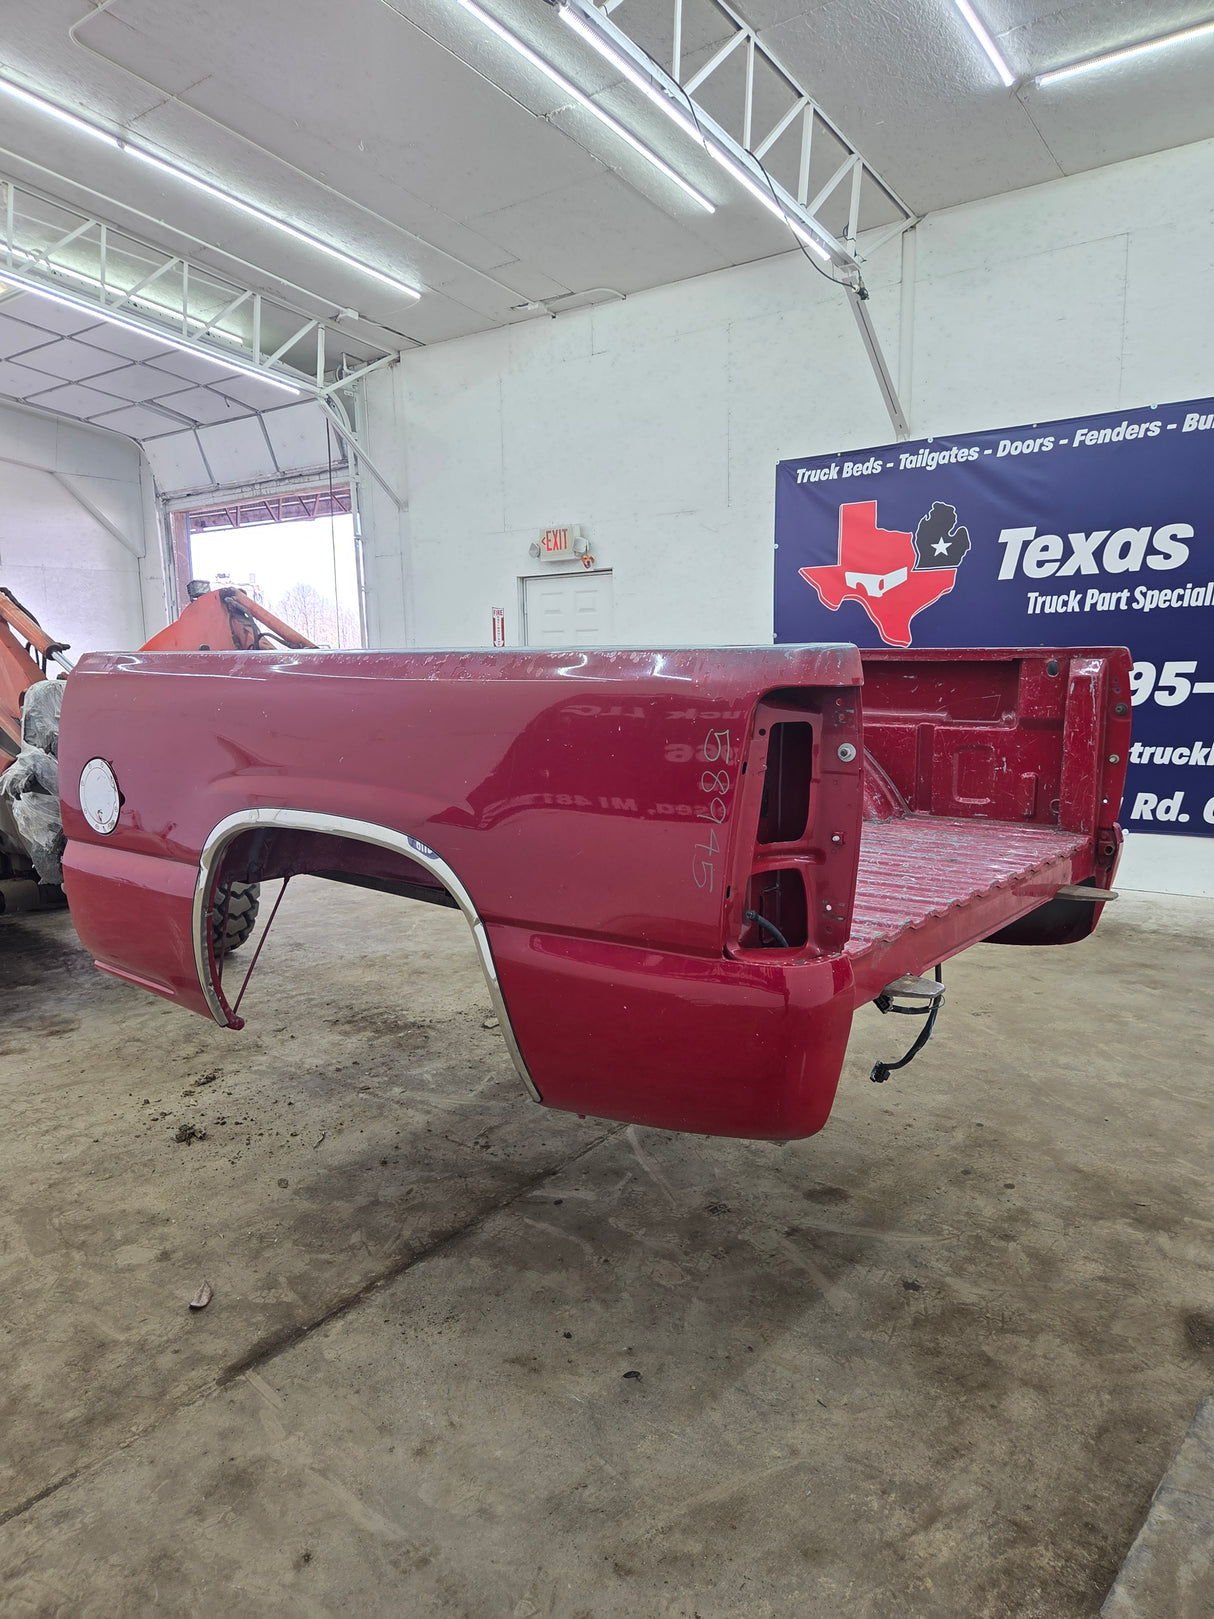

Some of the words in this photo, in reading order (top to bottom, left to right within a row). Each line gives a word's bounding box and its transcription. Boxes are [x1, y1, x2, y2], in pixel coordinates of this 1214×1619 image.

[796, 466, 839, 484] Truck
[842, 457, 883, 478] Beds
[899, 446, 980, 471] Tailgates
[996, 435, 1055, 458] Doors
[1072, 417, 1161, 448] Fenders
[545, 528, 568, 551] EXIT
[998, 522, 1195, 581] Texas
[1027, 590, 1081, 615] Truck
[1081, 587, 1131, 612] Part
[693, 728, 730, 893] 58945
[1130, 791, 1190, 823] Rd.
